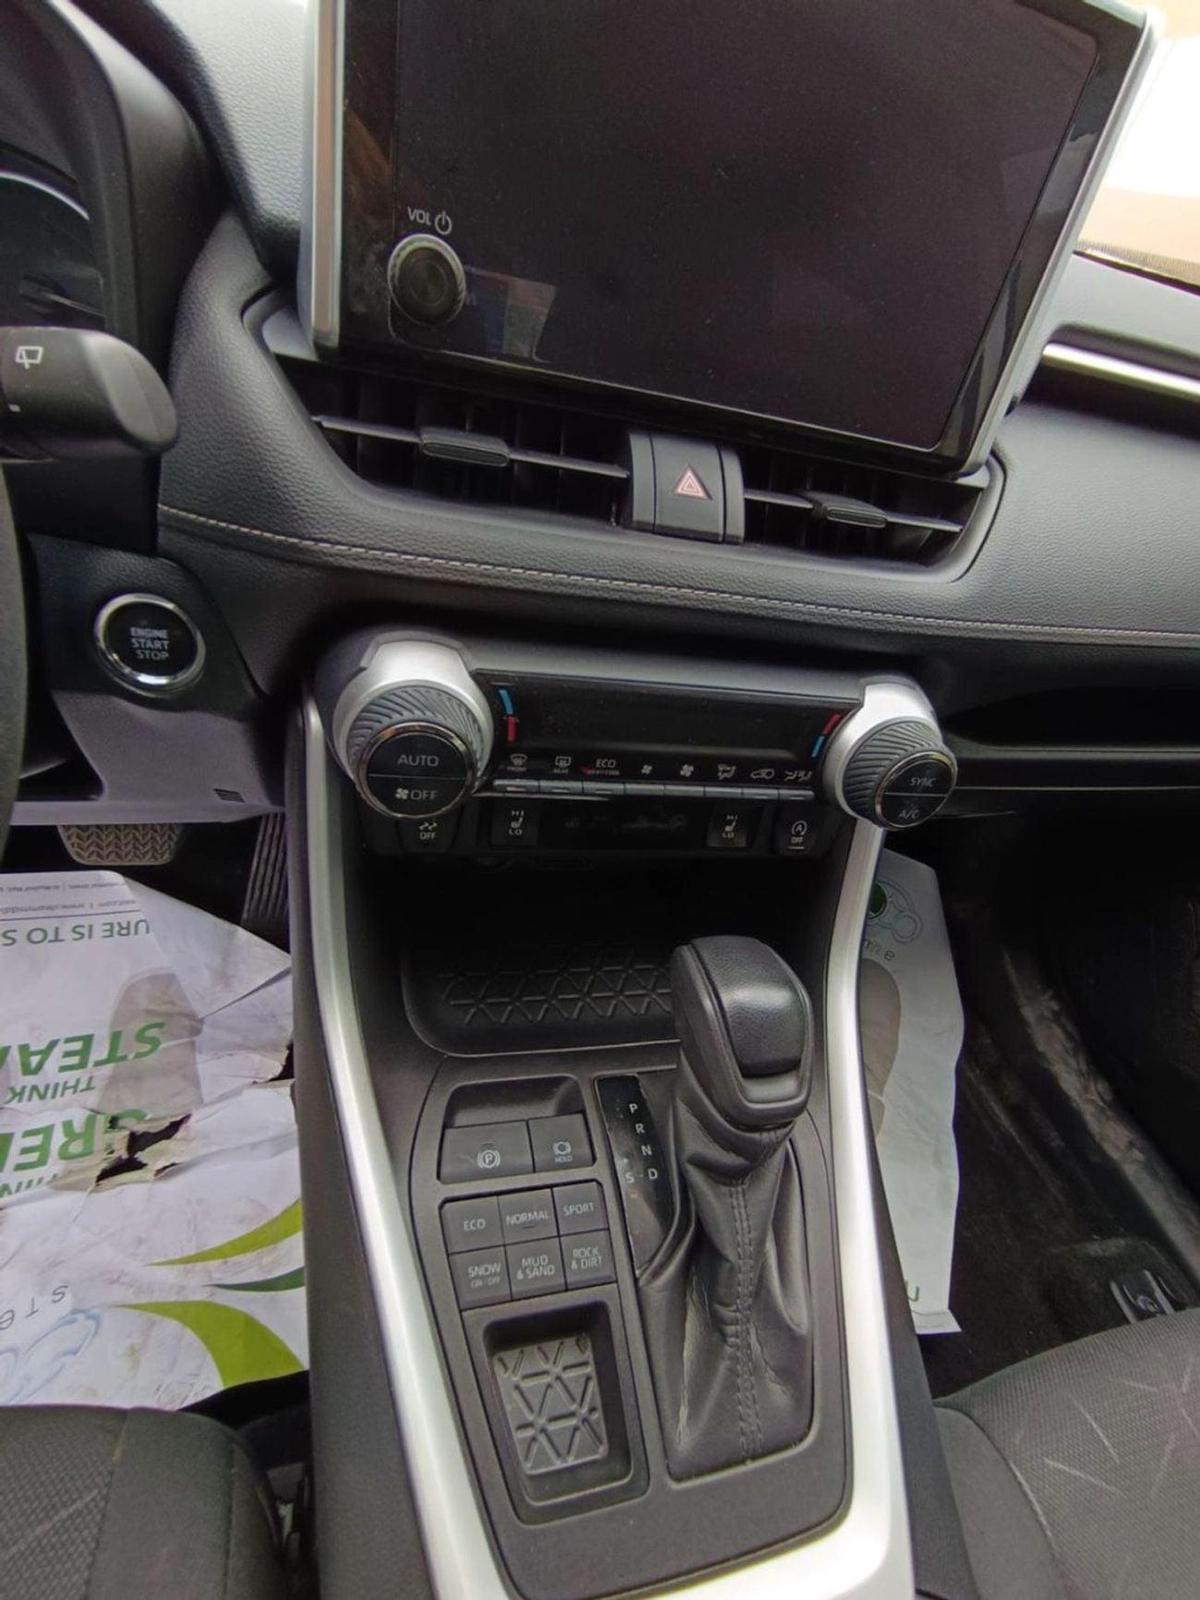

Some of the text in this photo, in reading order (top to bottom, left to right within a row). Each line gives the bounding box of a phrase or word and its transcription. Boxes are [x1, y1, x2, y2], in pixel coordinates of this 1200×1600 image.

[407, 206, 432, 226] VOL
[130, 626, 168, 639] ENGINE
[131, 638, 169, 650] START
[136, 649, 169, 660] STOP
[398, 754, 440, 767] AUTO
[595, 758, 617, 768] ECO
[910, 777, 937, 788] SYNC
[411, 790, 438, 800] OFF
[419, 832, 437, 840] OFF
[27, 927, 65, 945] TO
[71, 924, 94, 942] IS
[3, 1076, 96, 1105] THINK
[628, 1103, 639, 1114] P
[635, 1123, 646, 1134] R
[641, 1144, 653, 1156] N
[555, 1155, 574, 1163] HOLD
[648, 1168, 658, 1180] D
[563, 1202, 595, 1217] SPORT
[506, 1210, 549, 1226] NORMAL
[463, 1218, 487, 1232] ECO
[572, 1247, 600, 1259] ROCK
[521, 1255, 549, 1269] MUD
[580, 1256, 603, 1269] DIRT
[468, 1263, 502, 1279] SNOW
[527, 1265, 556, 1280] SAND
